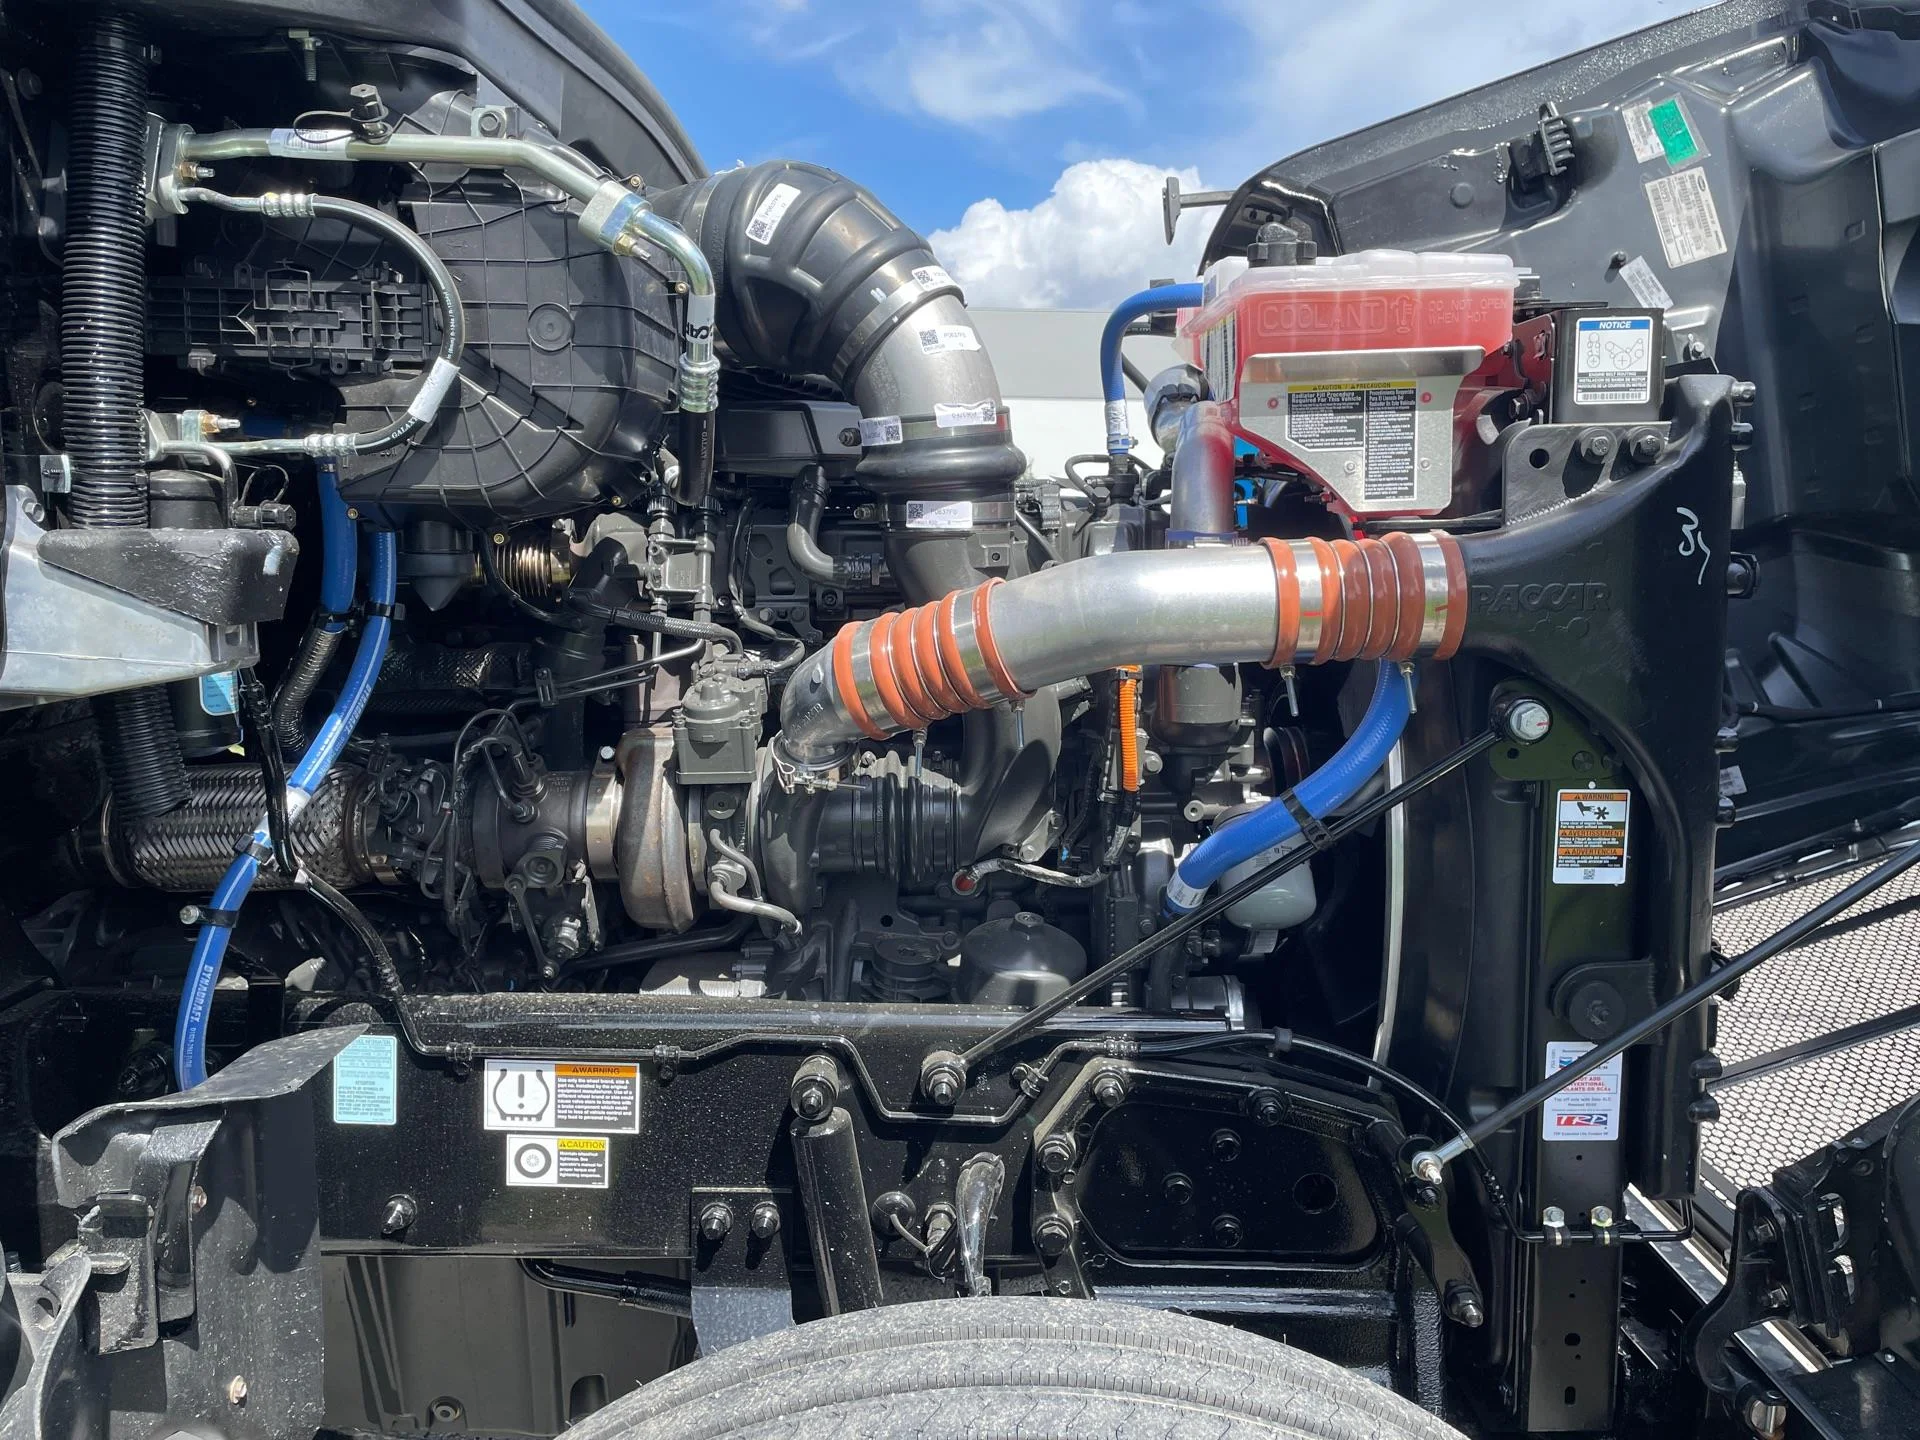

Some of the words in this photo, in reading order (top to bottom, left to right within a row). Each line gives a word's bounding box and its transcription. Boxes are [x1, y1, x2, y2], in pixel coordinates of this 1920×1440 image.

[1451, 299, 1471, 310] NOT
[1263, 303, 1379, 329] COOLANT
[1429, 312, 1452, 324] WHEN
[1468, 312, 1487, 323] HOT
[1599, 321, 1632, 329] NOTICE
[1472, 582, 1611, 611] PACCAR
[1560, 1113, 1607, 1125] TRP
